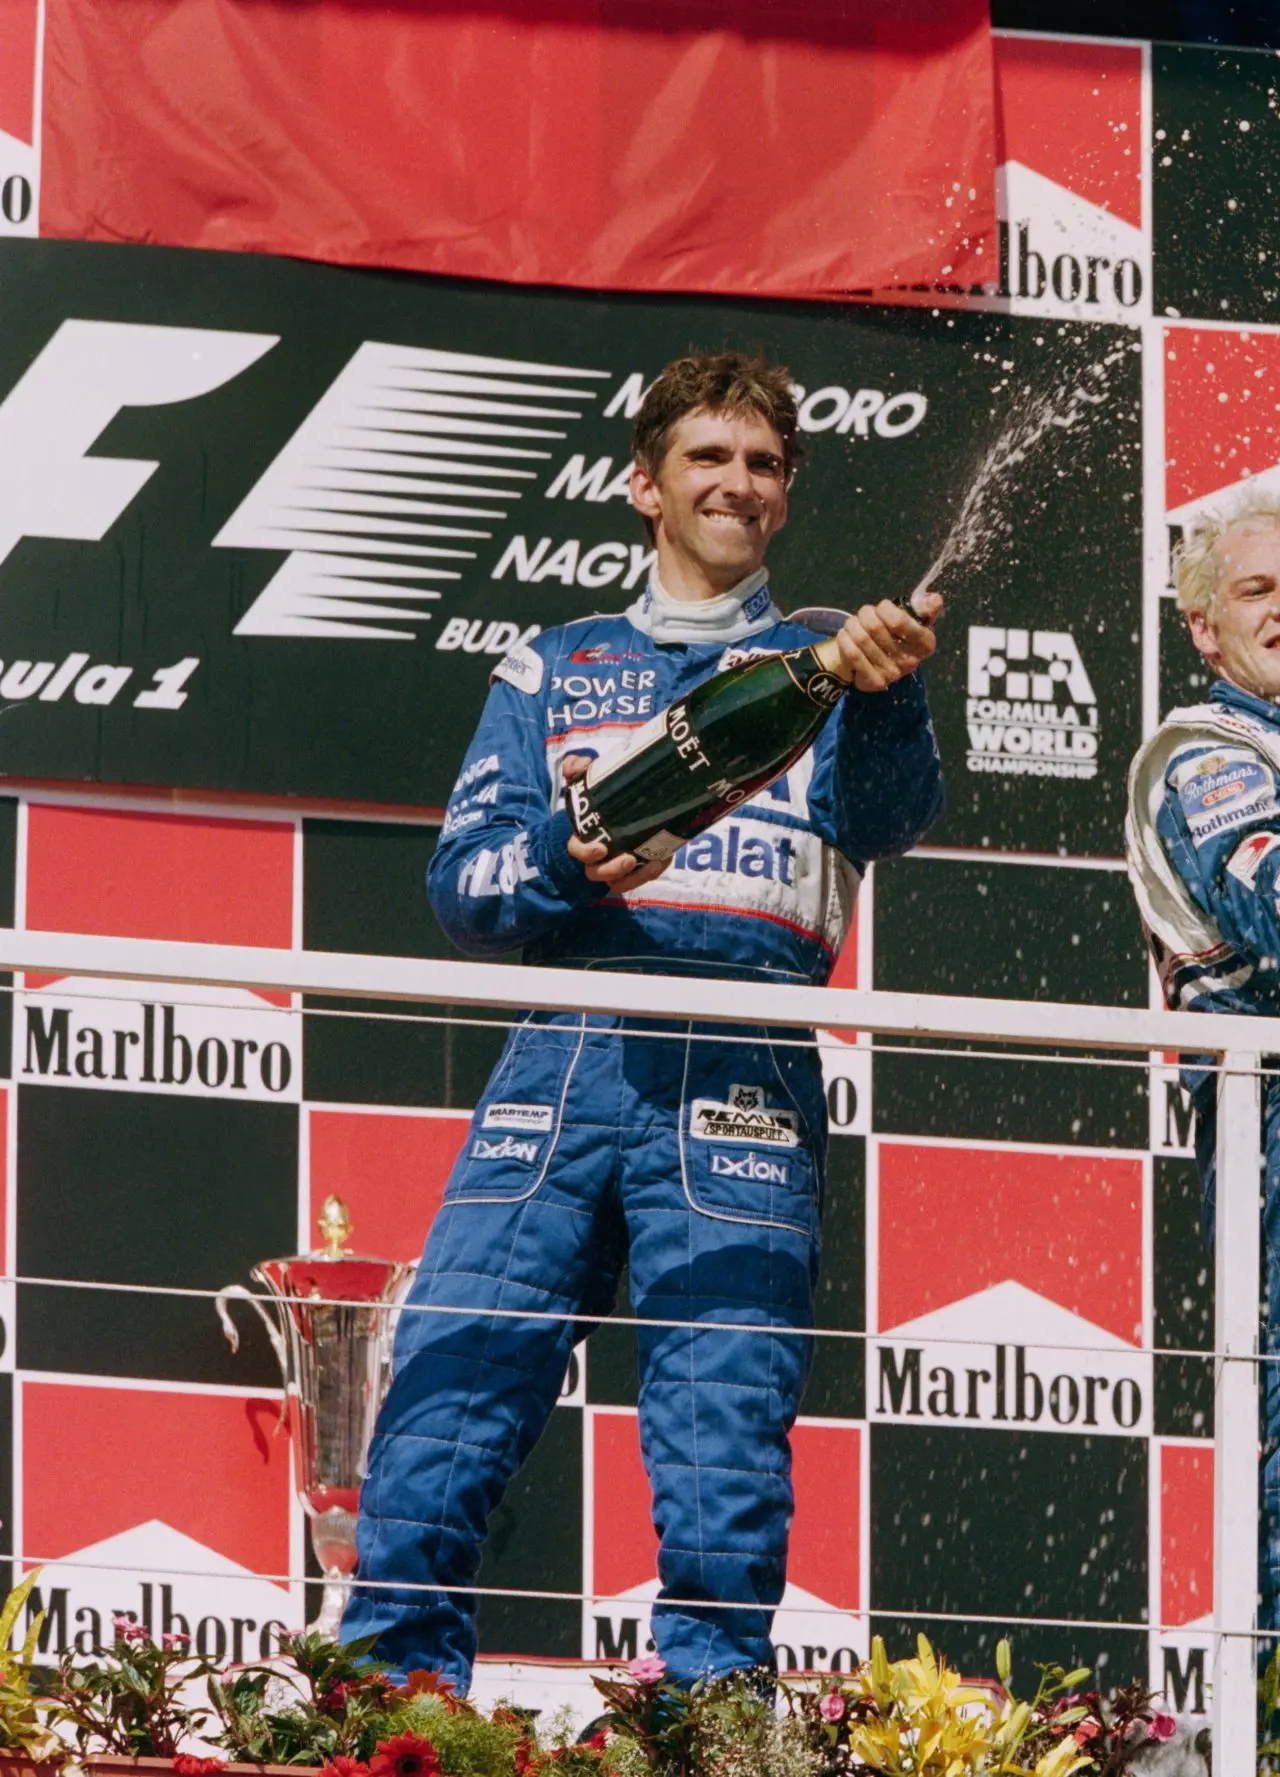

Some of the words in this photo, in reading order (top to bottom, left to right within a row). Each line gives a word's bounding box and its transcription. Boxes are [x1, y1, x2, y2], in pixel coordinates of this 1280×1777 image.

[995, 218, 1143, 308] lboro
[133, 657, 200, 710] 1
[968, 625, 1097, 705] FIA
[547, 695, 652, 729] HORSE
[669, 704, 711, 772] MOËT
[966, 699, 1080, 726] FORMULA
[1086, 707, 1098, 728] 1
[966, 757, 1098, 780] CHAMPIONSHIP
[967, 725, 1098, 759] WORLD
[22, 1003, 292, 1092] Marlboro
[697, 1108, 793, 1129] REMUS
[876, 1346, 1143, 1429] Marlboro
